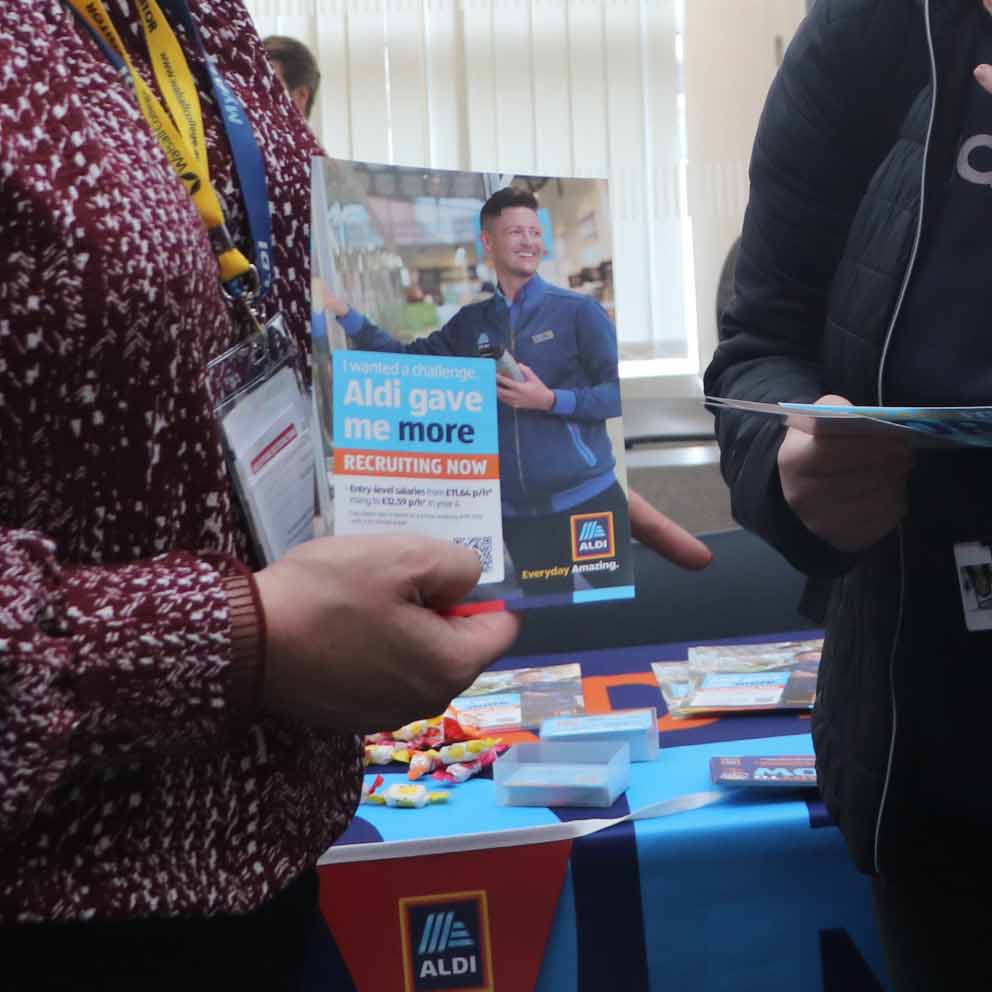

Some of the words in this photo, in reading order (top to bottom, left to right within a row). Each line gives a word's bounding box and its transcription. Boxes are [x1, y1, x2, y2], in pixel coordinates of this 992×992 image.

[343, 378, 401, 407] Aldi
[408, 388, 483, 416] gave
[343, 417, 391, 441] me
[398, 420, 476, 444] more
[343, 454, 441, 474] RECRUITING
[446, 458, 488, 475] NOW
[579, 539, 608, 551] ALDI
[521, 566, 570, 581] Everyday
[571, 560, 619, 574] Amazing.
[419, 955, 477, 978] ALDI
